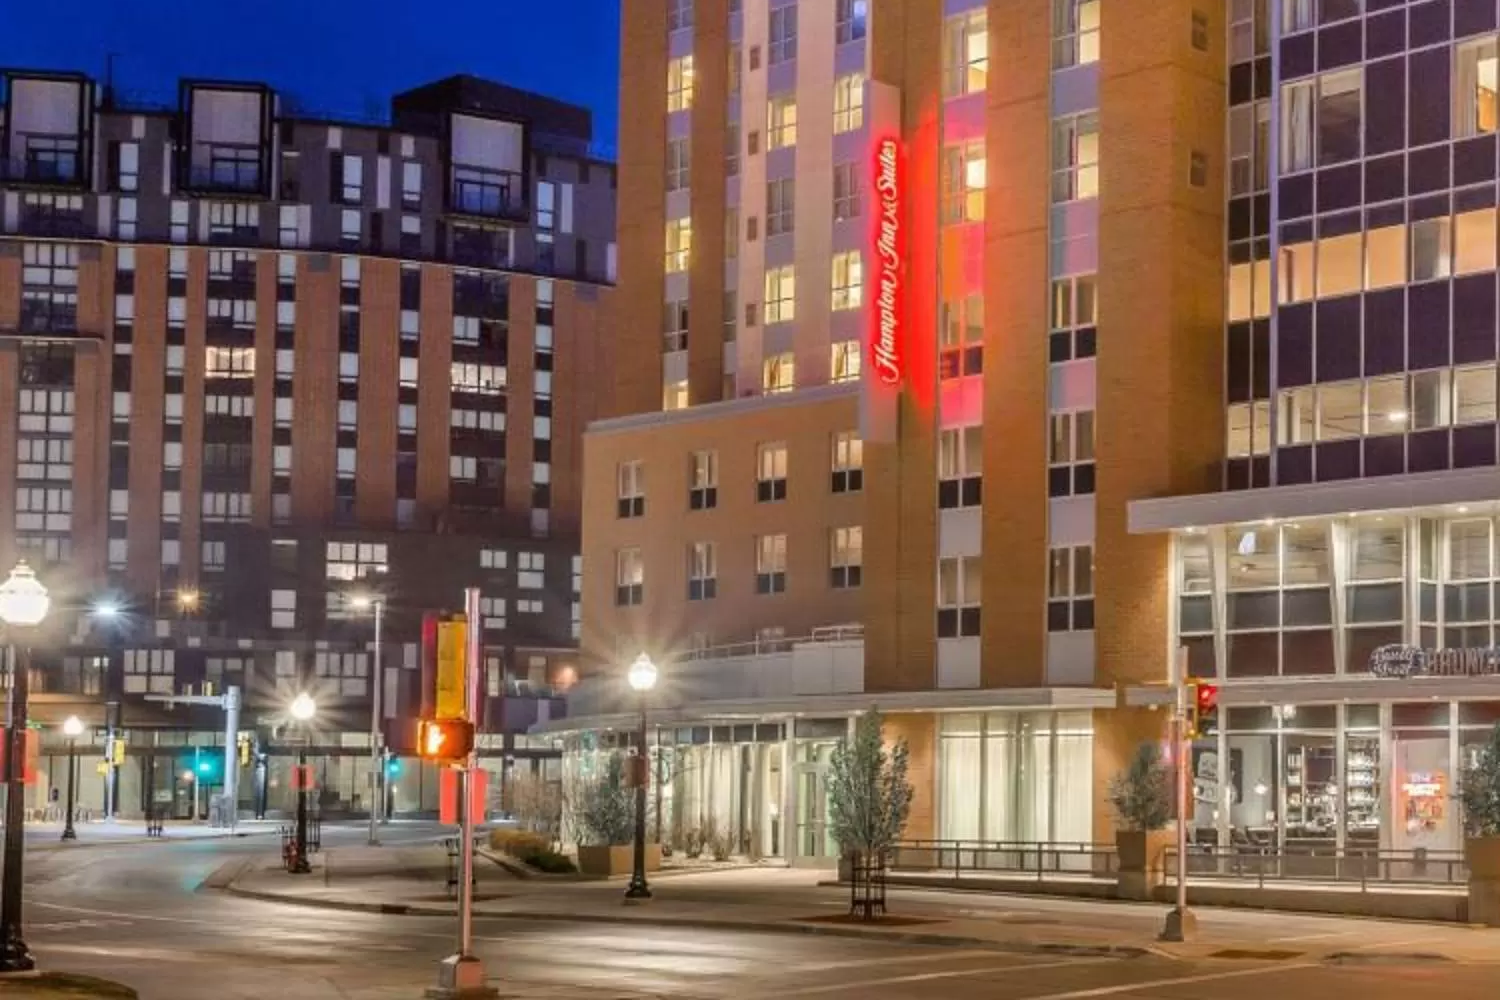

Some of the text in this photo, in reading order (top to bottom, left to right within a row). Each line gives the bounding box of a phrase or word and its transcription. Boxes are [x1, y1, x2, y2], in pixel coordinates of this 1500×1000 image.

[876, 140, 897, 200] Suites
[876, 213, 899, 270] Inn
[872, 269, 899, 383] Hampton
